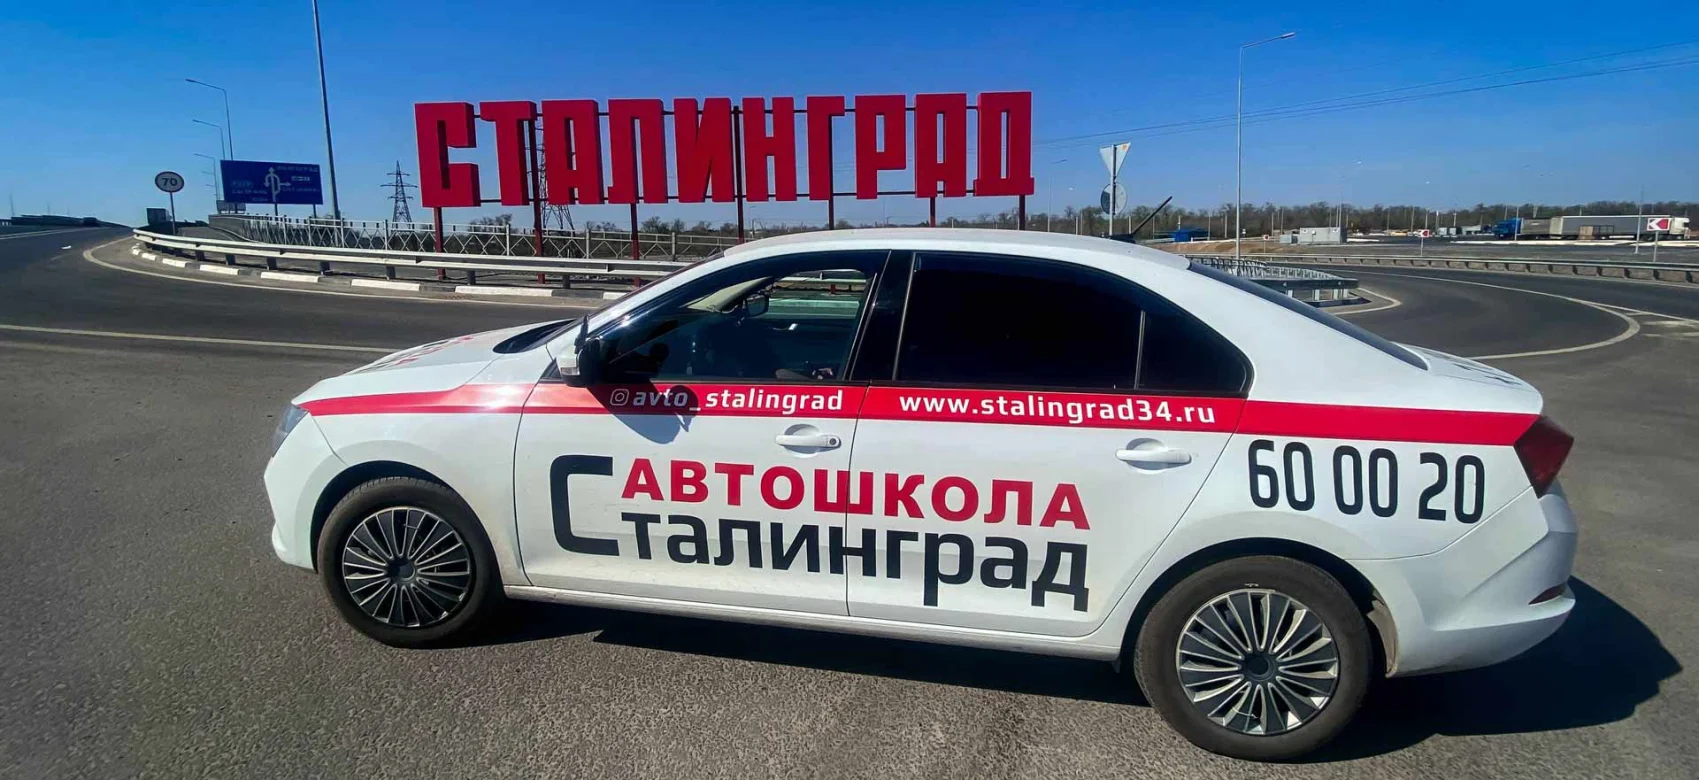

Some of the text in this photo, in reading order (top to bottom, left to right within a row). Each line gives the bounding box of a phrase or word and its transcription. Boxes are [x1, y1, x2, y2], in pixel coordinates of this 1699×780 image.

[162, 177, 178, 187] 70
[414, 91, 1035, 208] СТАЛИНГРАД
[633, 388, 843, 415] avto_stalingrad
[899, 395, 1216, 424] www.stalingrad34.ru
[621, 457, 1092, 530] АВТОШКОЛА
[1248, 439, 1486, 524] 60 00 20
[549, 454, 1090, 613] Сталинград
